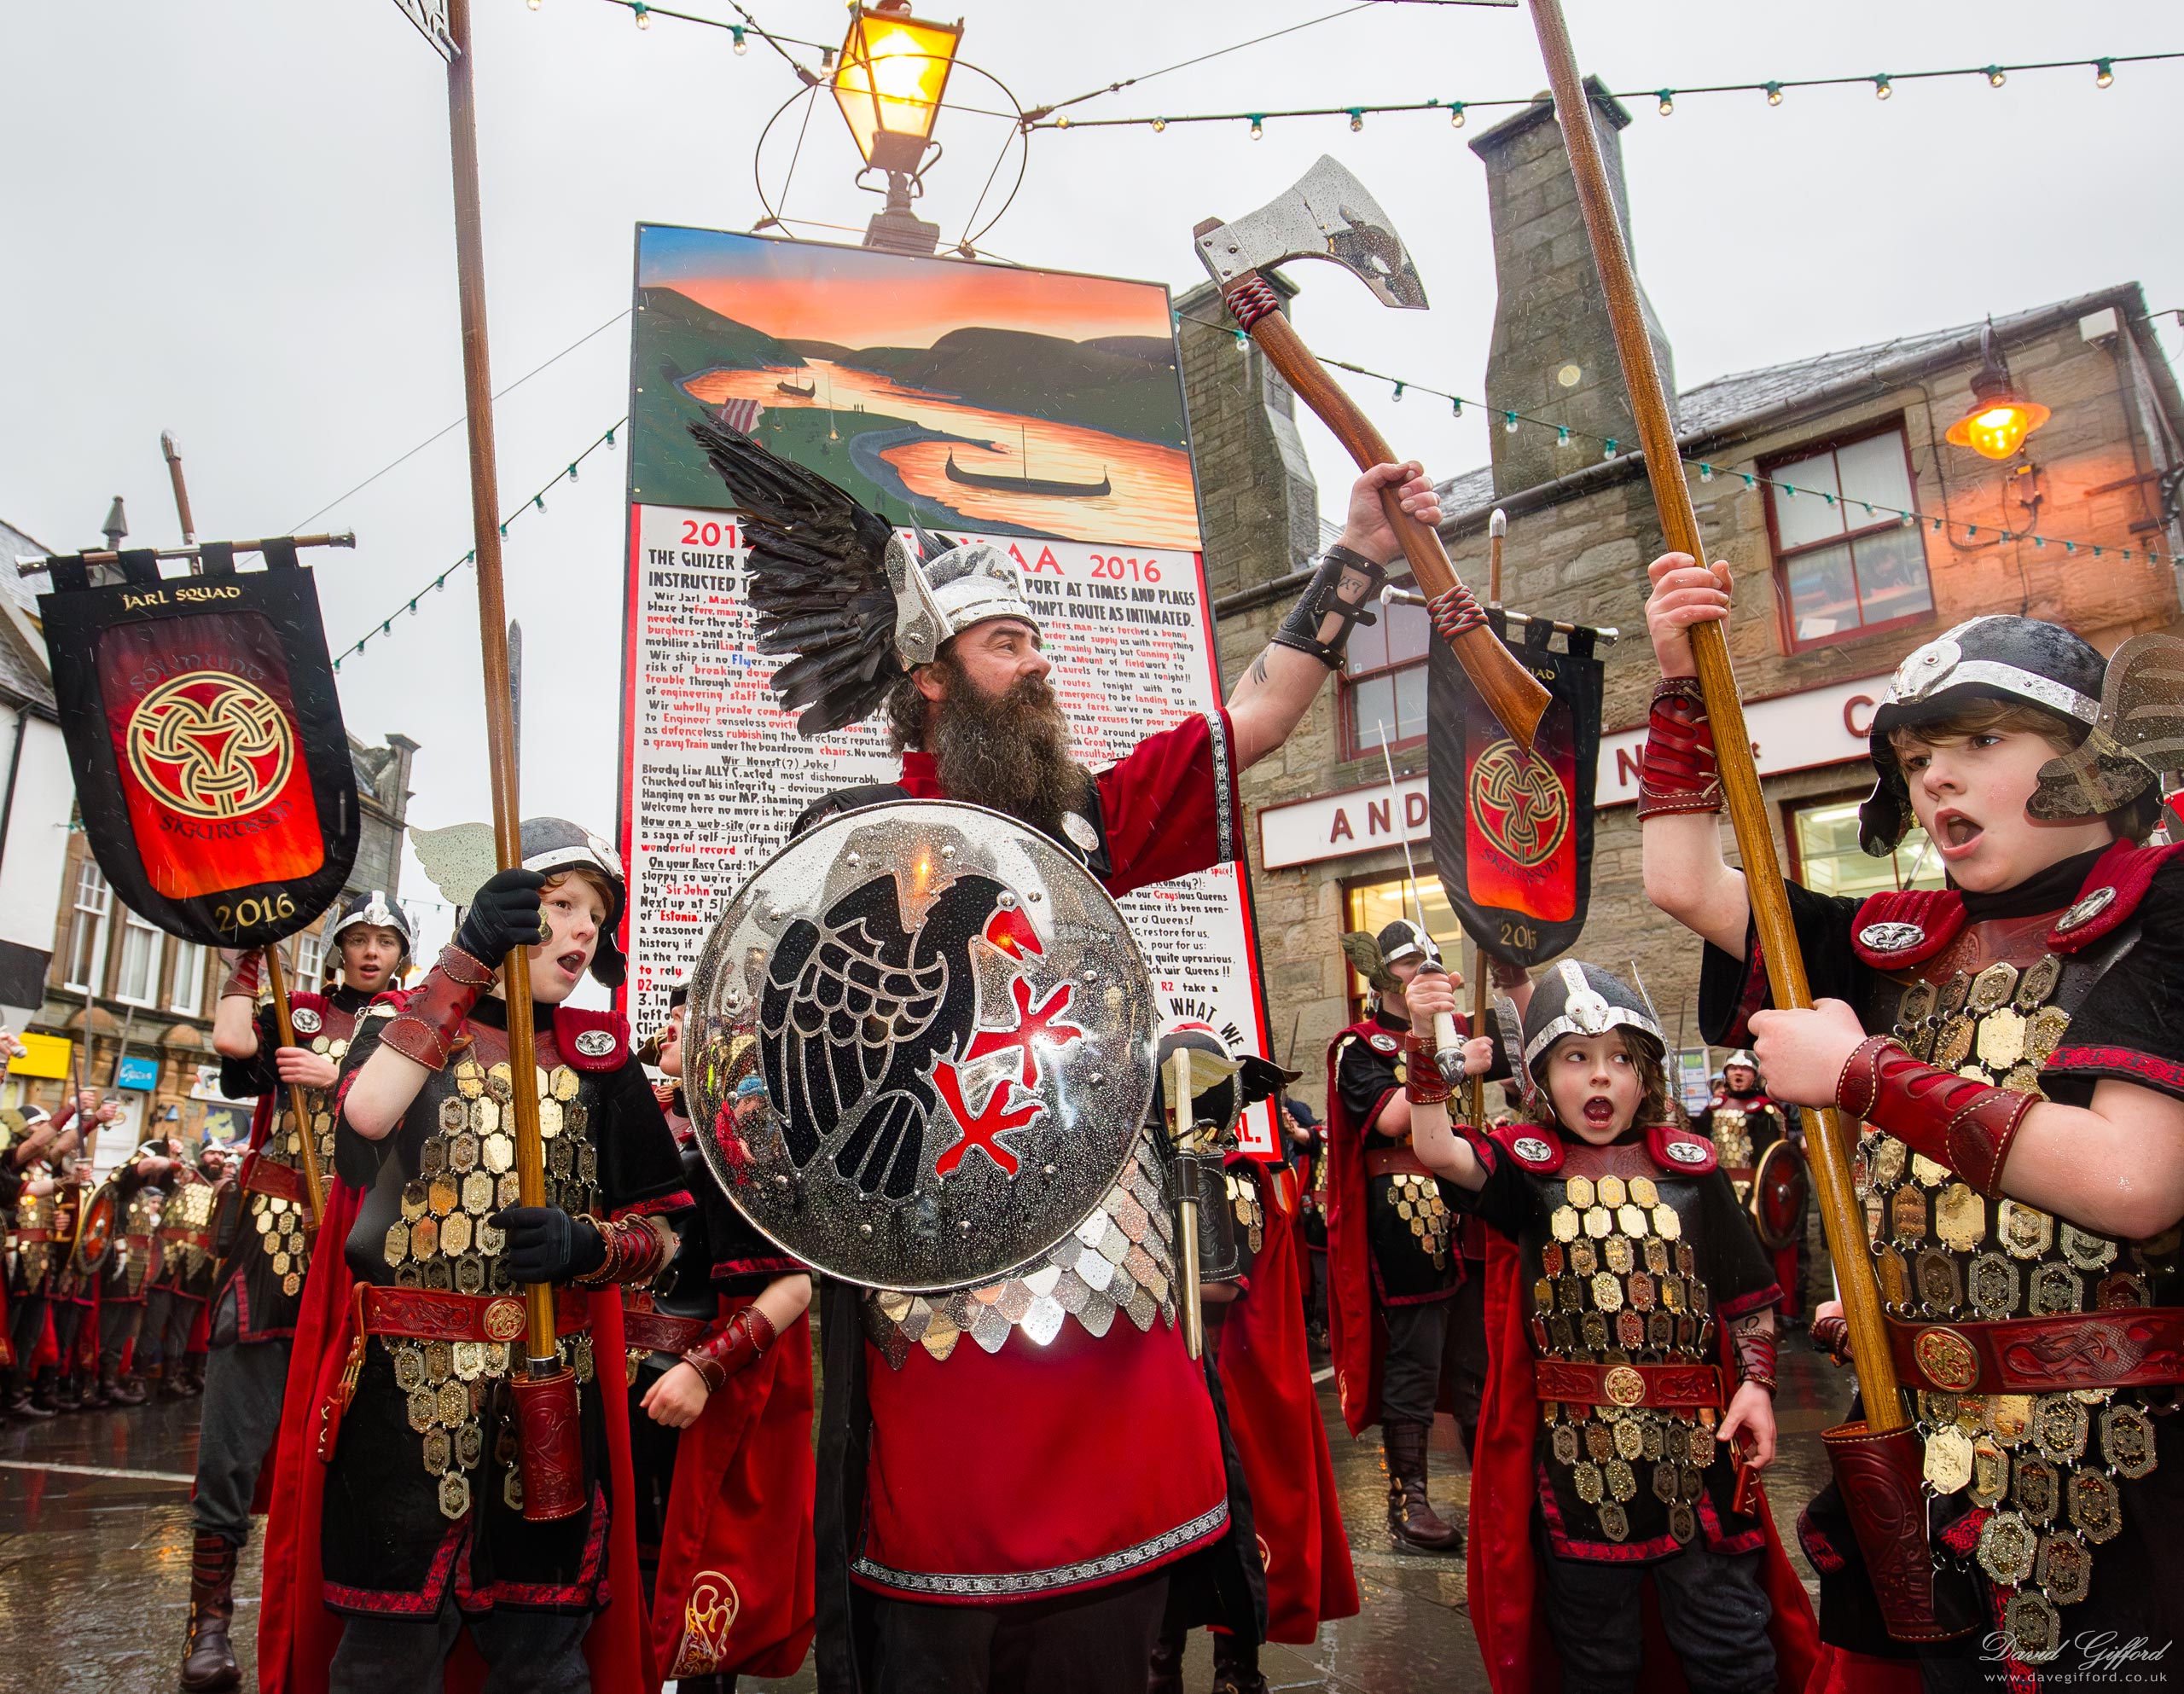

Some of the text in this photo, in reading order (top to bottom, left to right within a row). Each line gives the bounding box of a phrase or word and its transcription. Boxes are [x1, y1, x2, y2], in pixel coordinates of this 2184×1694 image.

[682, 520, 756, 549] 201
[648, 549, 675, 566] THE
[682, 552, 735, 570] GUIZER
[1089, 554, 1161, 583] 2016
[649, 571, 735, 592] INSTRUCTED
[175, 587, 241, 601] SQUAD
[1066, 582, 1082, 597] AT
[1087, 583, 1128, 600] TIMES
[1131, 587, 1154, 602] AND
[1159, 589, 1194, 606] PLACES
[648, 601, 677, 612] blaze
[1069, 603, 1106, 620] ROUTE
[1109, 606, 1124, 622] AS
[648, 615, 705, 626] needed for
[648, 625, 694, 637] burghers
[1118, 626, 1149, 635] torched
[646, 637, 688, 648] mobilise
[1044, 632, 1066, 641] order
[1091, 636, 1118, 647] supply
[1132, 638, 1150, 647] with
[1153, 641, 1194, 652] everything
[650, 650, 670, 660] Wir
[676, 652, 697, 664] ship
[1064, 645, 1091, 655] mainly
[1095, 646, 1116, 657] hairy
[1136, 649, 1169, 661] Cunning
[1047, 653, 1166, 670] right fieldwork
[646, 663, 742, 680] risk breaking
[1057, 664, 1091, 675] Laurels
[1097, 668, 1109, 676] for
[1115, 670, 1136, 678] them
[689, 676, 730, 690] through
[1102, 682, 1133, 692] tonight
[660, 687, 757, 702] engineering staff
[1059, 691, 1167, 706] emergency landing
[649, 699, 669, 710] Wir
[673, 701, 710, 716] wholly
[715, 704, 752, 716] private
[664, 713, 766, 728] Engineer senseless
[1097, 716, 1129, 724] excuses
[661, 725, 796, 742] defenceless rubbishing the
[1073, 724, 1099, 735] SLAP
[1103, 728, 1136, 737] around
[653, 740, 683, 751] gravy
[686, 739, 708, 749] train
[712, 740, 738, 751] under
[741, 741, 756, 751] the
[759, 742, 813, 755] boardroom
[722, 756, 740, 765] Wir
[642, 764, 879, 785] Bloody Liar ALLY acted most dishonourably
[642, 776, 824, 793] Chucked out his integrity devious
[642, 789, 683, 803] Hanging
[762, 795, 803, 809] shaming
[642, 801, 687, 813] Welcome
[691, 803, 713, 814] here
[642, 816, 665, 827] Now
[653, 832, 679, 843] saga
[683, 831, 694, 840] of
[642, 843, 754, 856] wonderful record of
[649, 856, 664, 867] On
[666, 861, 689, 871] your
[693, 858, 715, 869] Race
[642, 871, 677, 885] sloppy
[643, 883, 733, 897] by out
[1196, 892, 1228, 902] Queens
[641, 896, 704, 910] Next up at
[1140, 902, 1161, 911] since
[1181, 903, 1201, 913] been
[215, 892, 296, 932] 2016
[640, 910, 652, 920] of
[653, 926, 703, 935] seasoned
[1143, 928, 1195, 937] restore for
[639, 938, 679, 951] history
[1152, 941, 1190, 950] pour for
[640, 951, 671, 961] in the
[1155, 953, 1179, 965] quite
[639, 965, 683, 978] to rely
[1161, 982, 1205, 992] R2 take
[638, 1009, 661, 1020] left
[1170, 998, 1217, 1024] WHAT
[1220, 1022, 1245, 1049] WE
